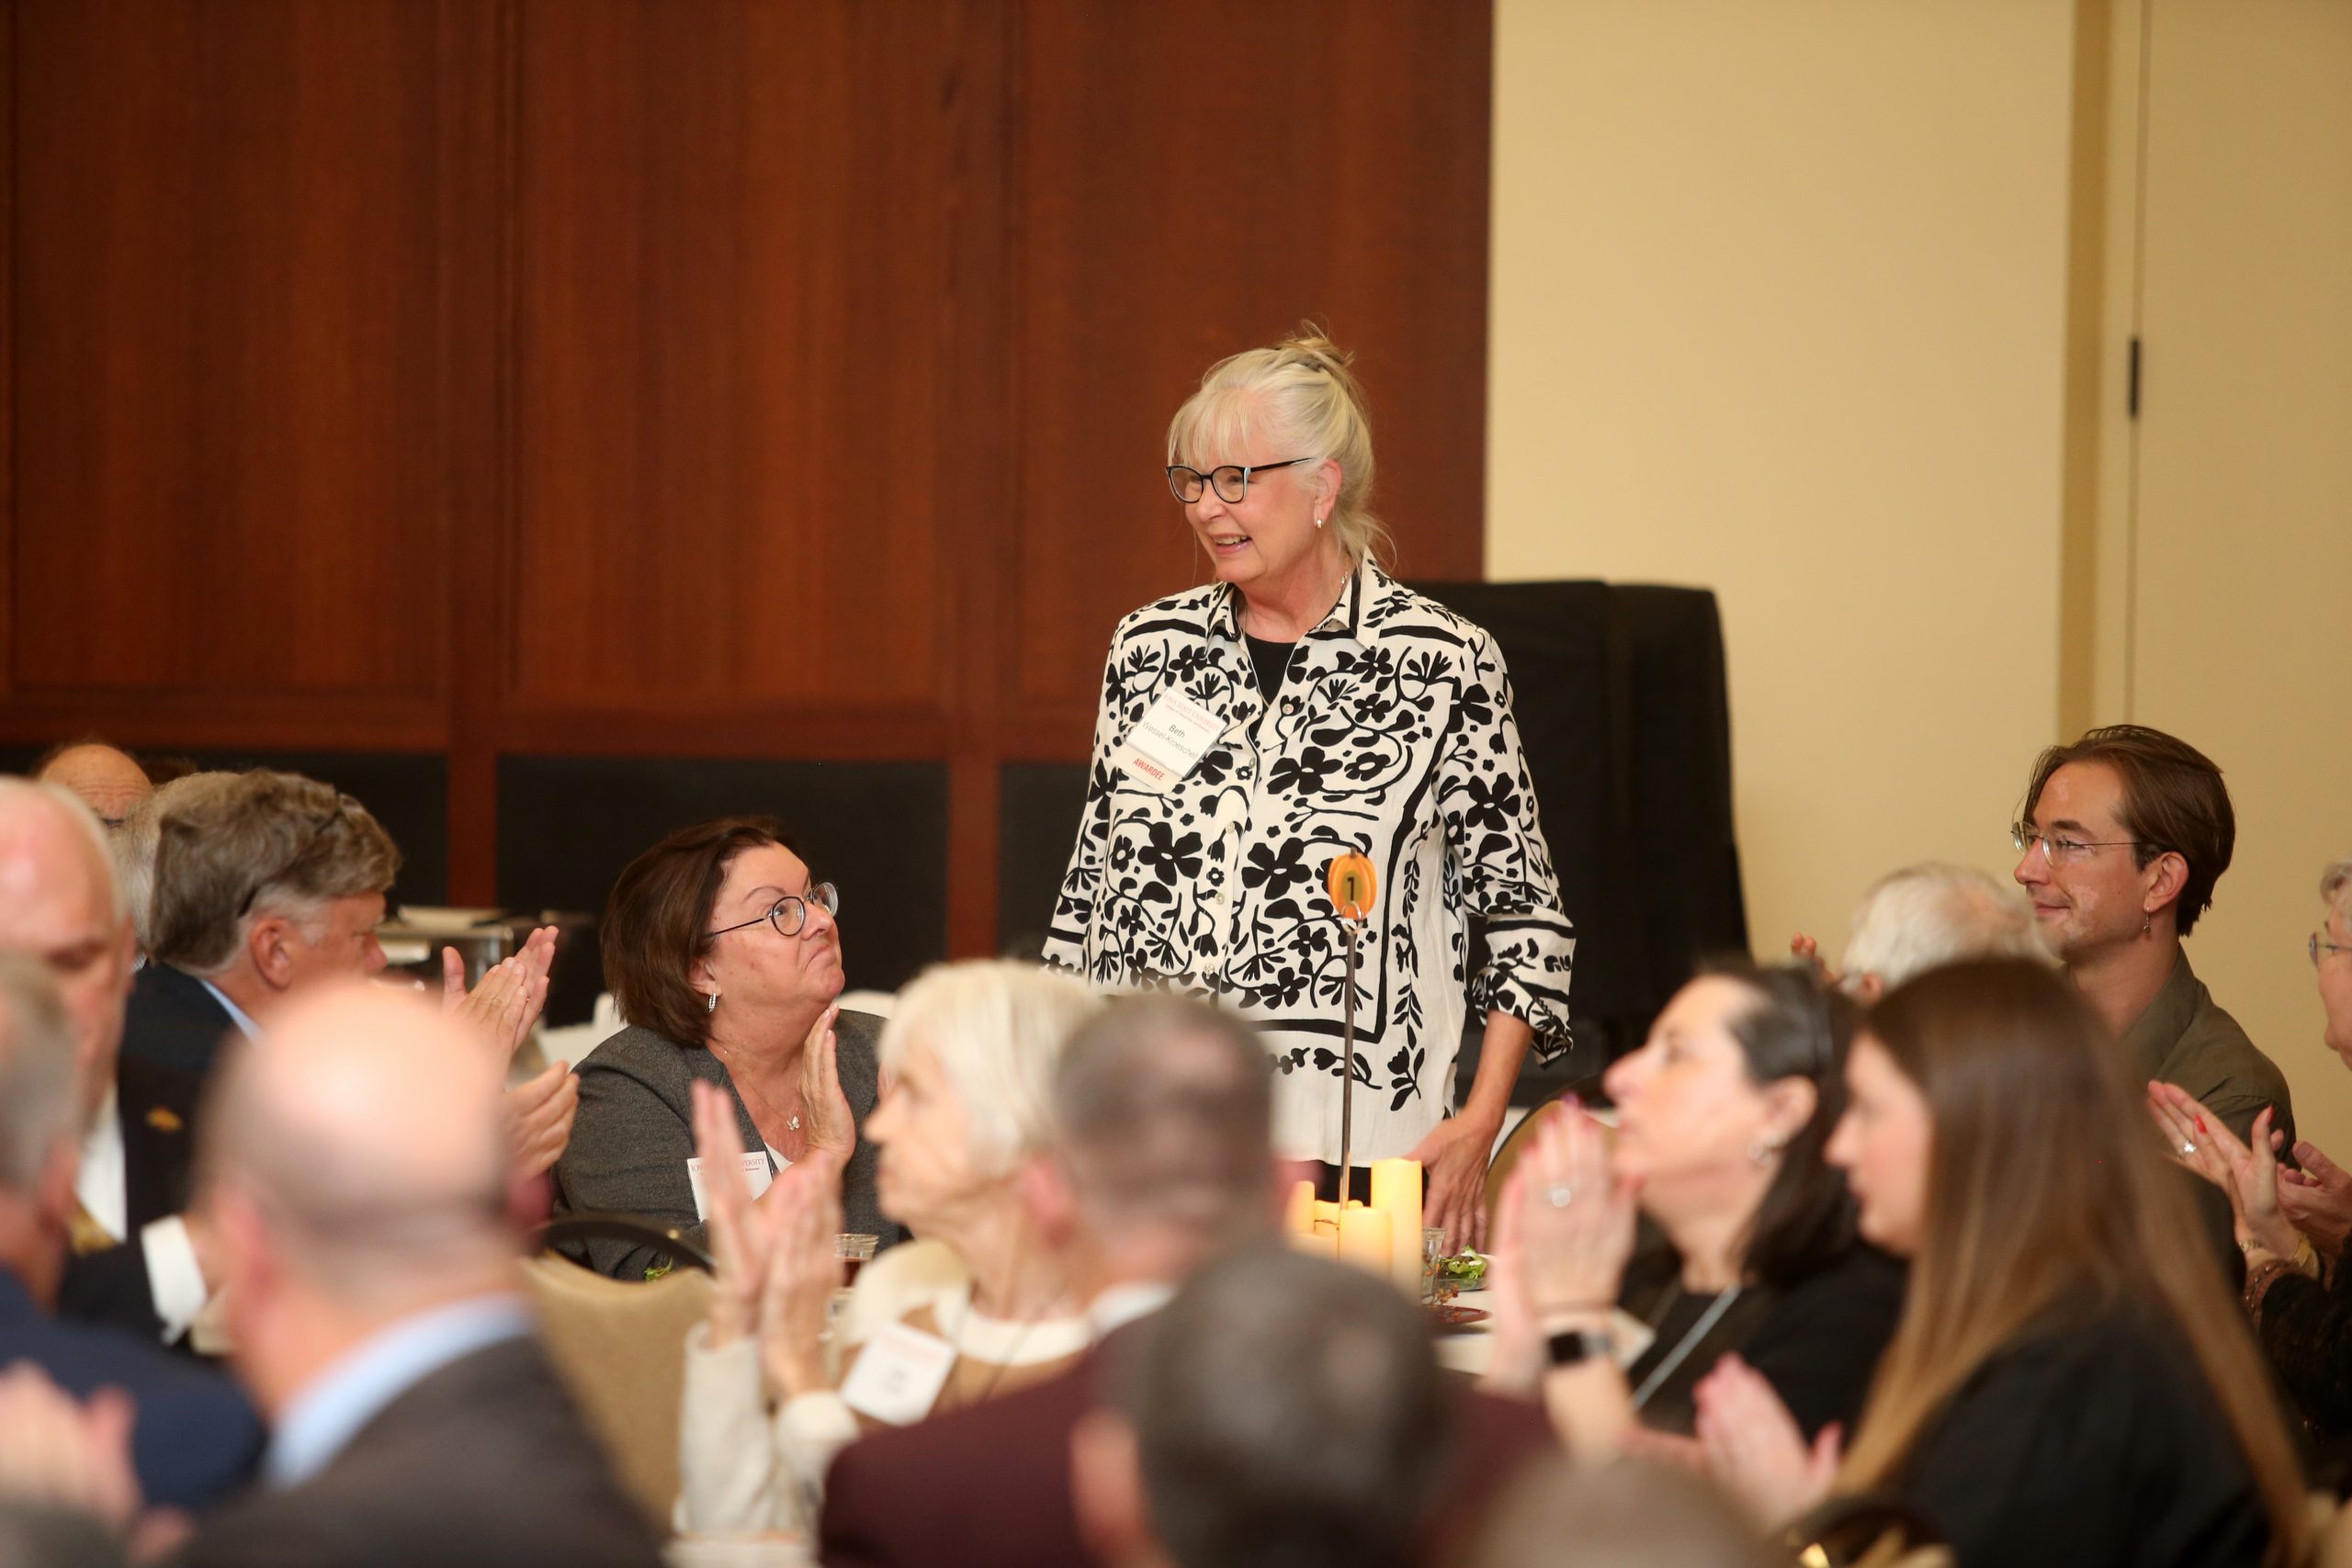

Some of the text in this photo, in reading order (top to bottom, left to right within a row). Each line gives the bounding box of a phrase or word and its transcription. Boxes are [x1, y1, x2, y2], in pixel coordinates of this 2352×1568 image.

[1169, 724, 1186, 739] Beth
[1132, 757, 1165, 780] AWARDEE
[1347, 877, 1354, 901] 1
